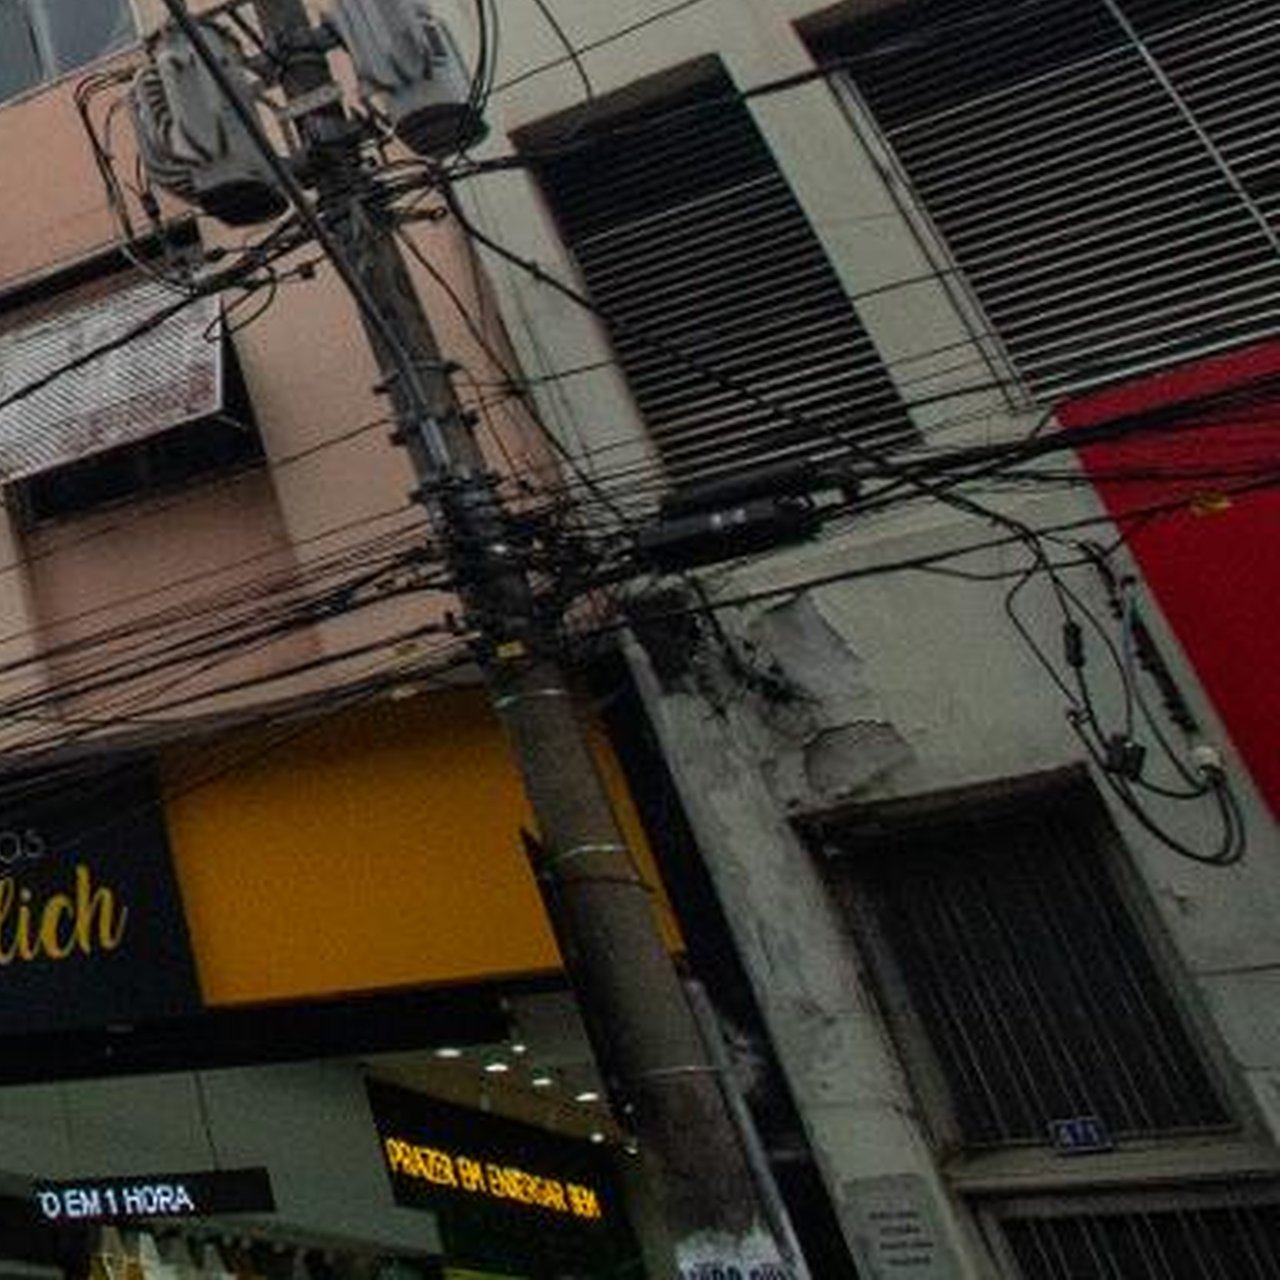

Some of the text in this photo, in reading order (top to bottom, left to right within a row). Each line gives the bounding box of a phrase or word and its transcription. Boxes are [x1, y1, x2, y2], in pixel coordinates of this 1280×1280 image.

[64, 1188, 103, 1218] EM
[104, 1187, 119, 1216] 1
[121, 1184, 196, 1216] HORA
